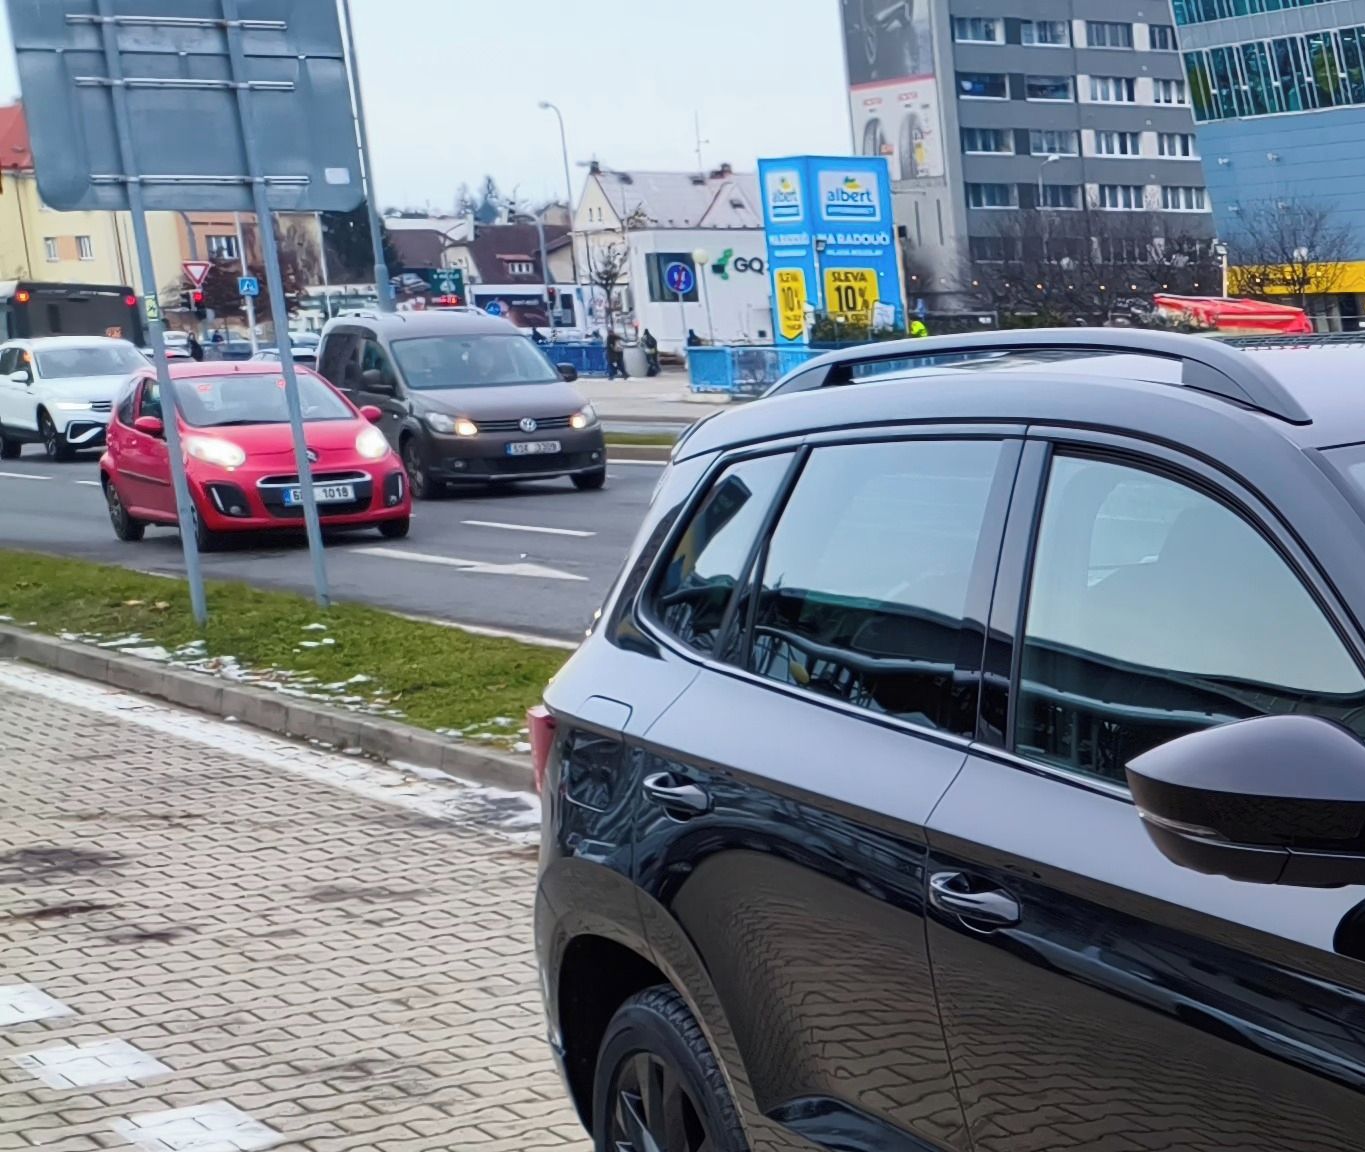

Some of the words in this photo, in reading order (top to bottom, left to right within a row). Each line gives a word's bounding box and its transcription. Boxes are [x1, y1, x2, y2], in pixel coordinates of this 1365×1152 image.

[827, 188, 873, 202] albert
[832, 272, 867, 283] SLEVA
[835, 286, 856, 312] 10
